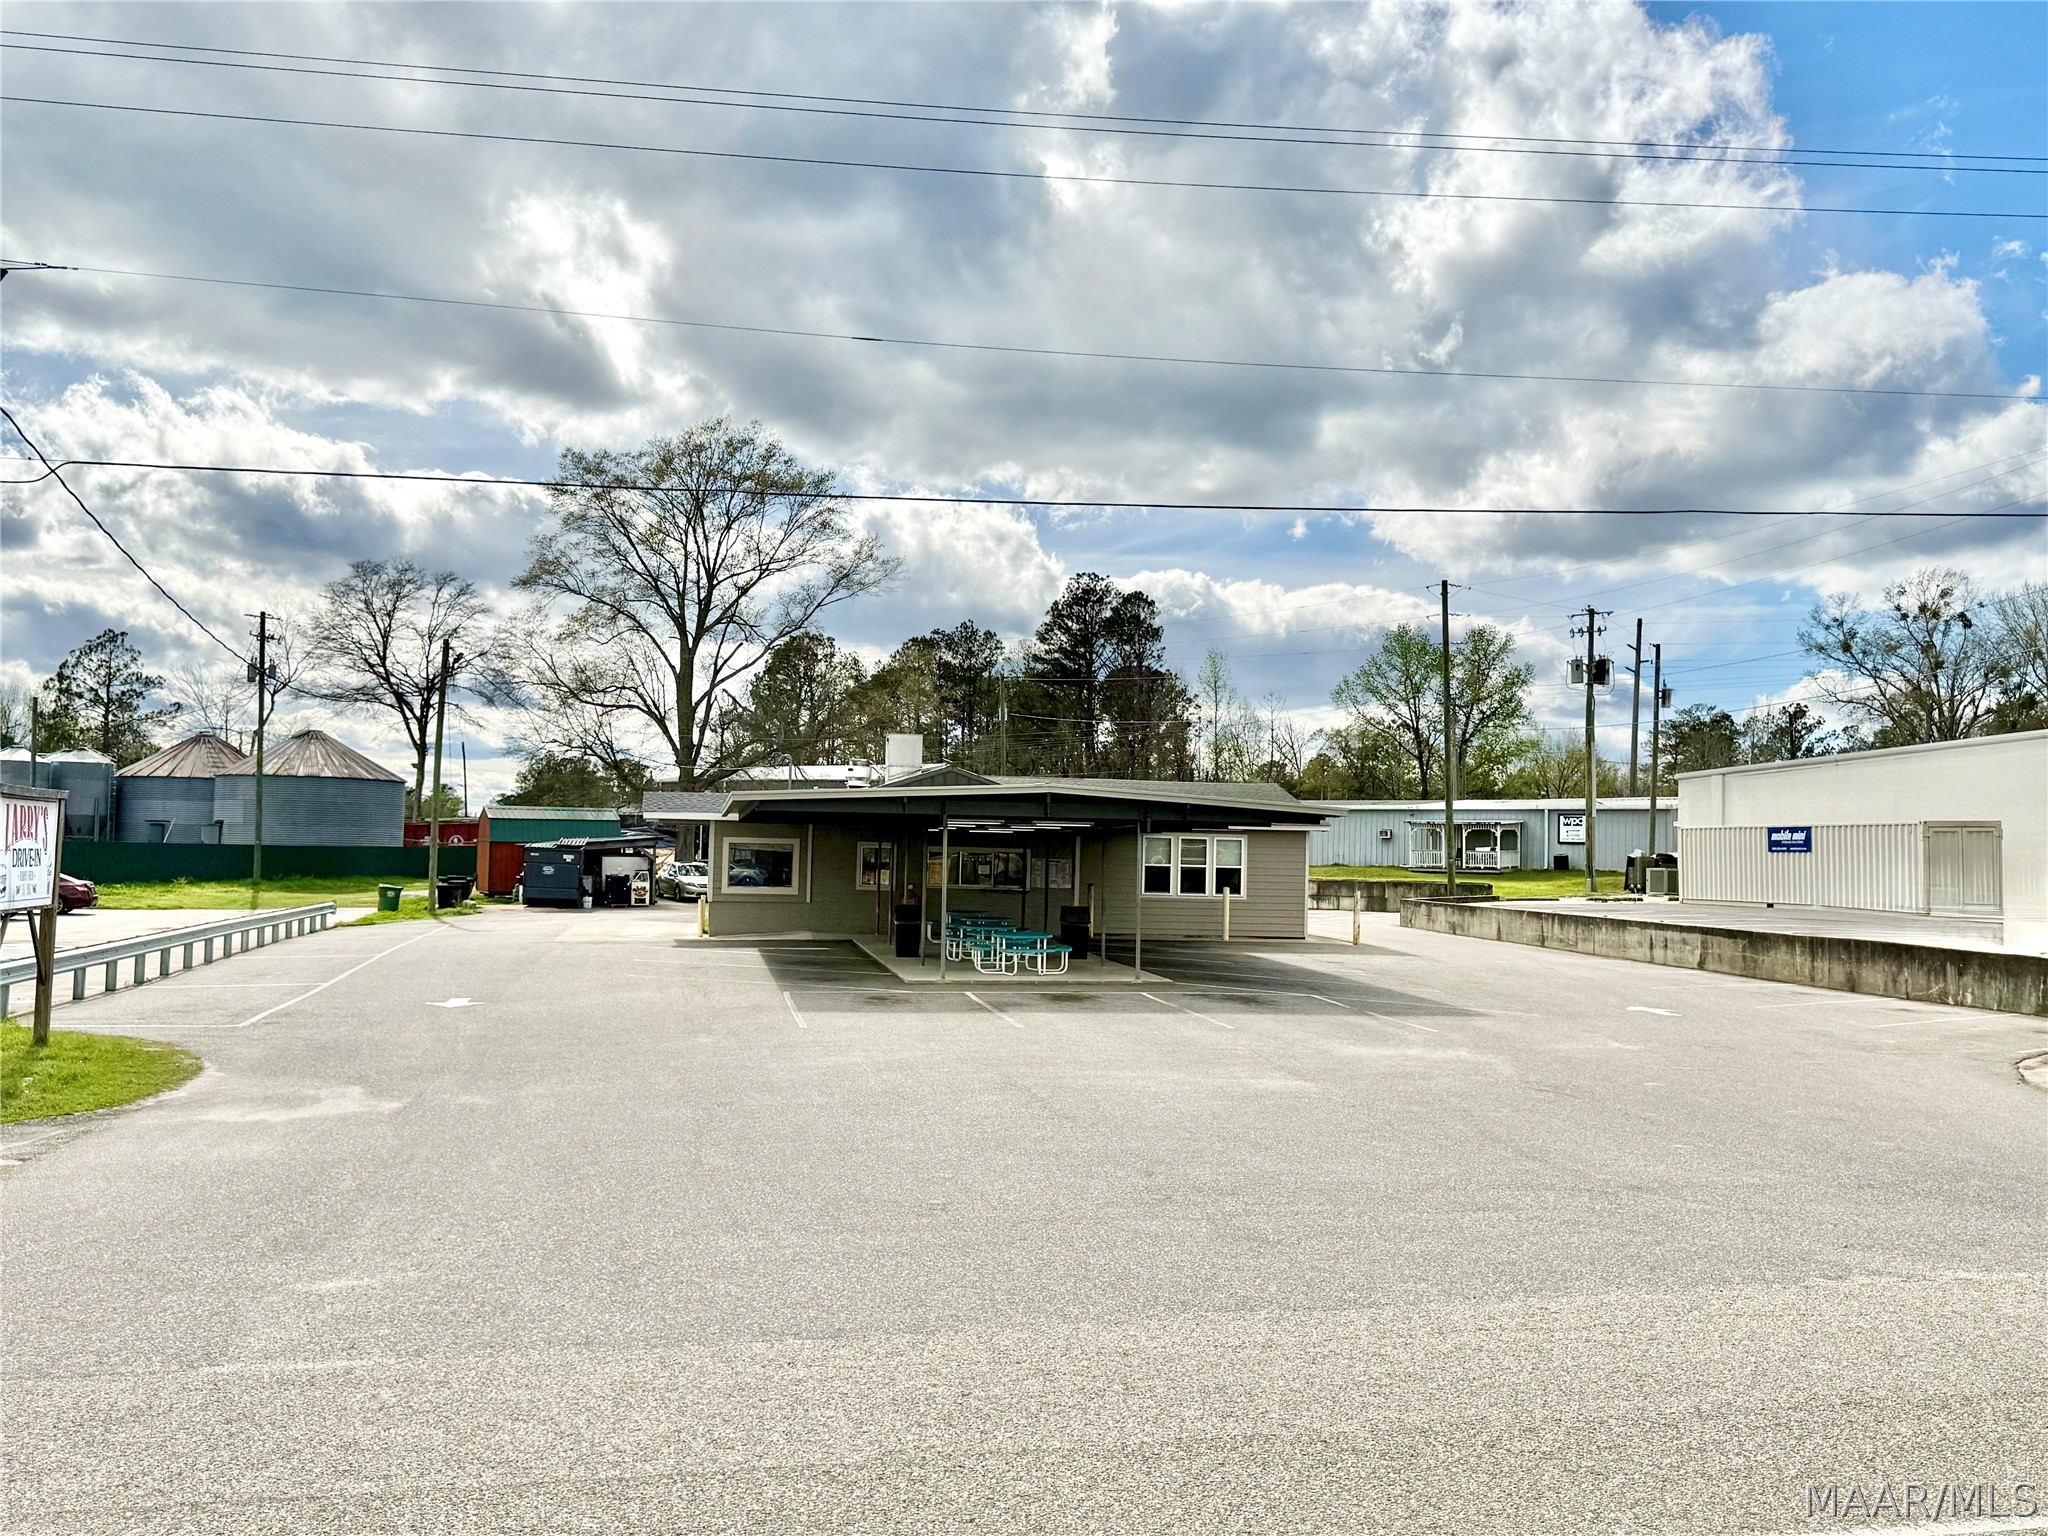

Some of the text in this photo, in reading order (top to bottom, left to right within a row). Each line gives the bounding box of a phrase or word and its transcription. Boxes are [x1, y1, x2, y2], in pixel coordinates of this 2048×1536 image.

[5, 803, 49, 855] LARRY'S
[1771, 829, 1807, 841] mobile mini
[12, 848, 42, 868] DRIVE-IN
